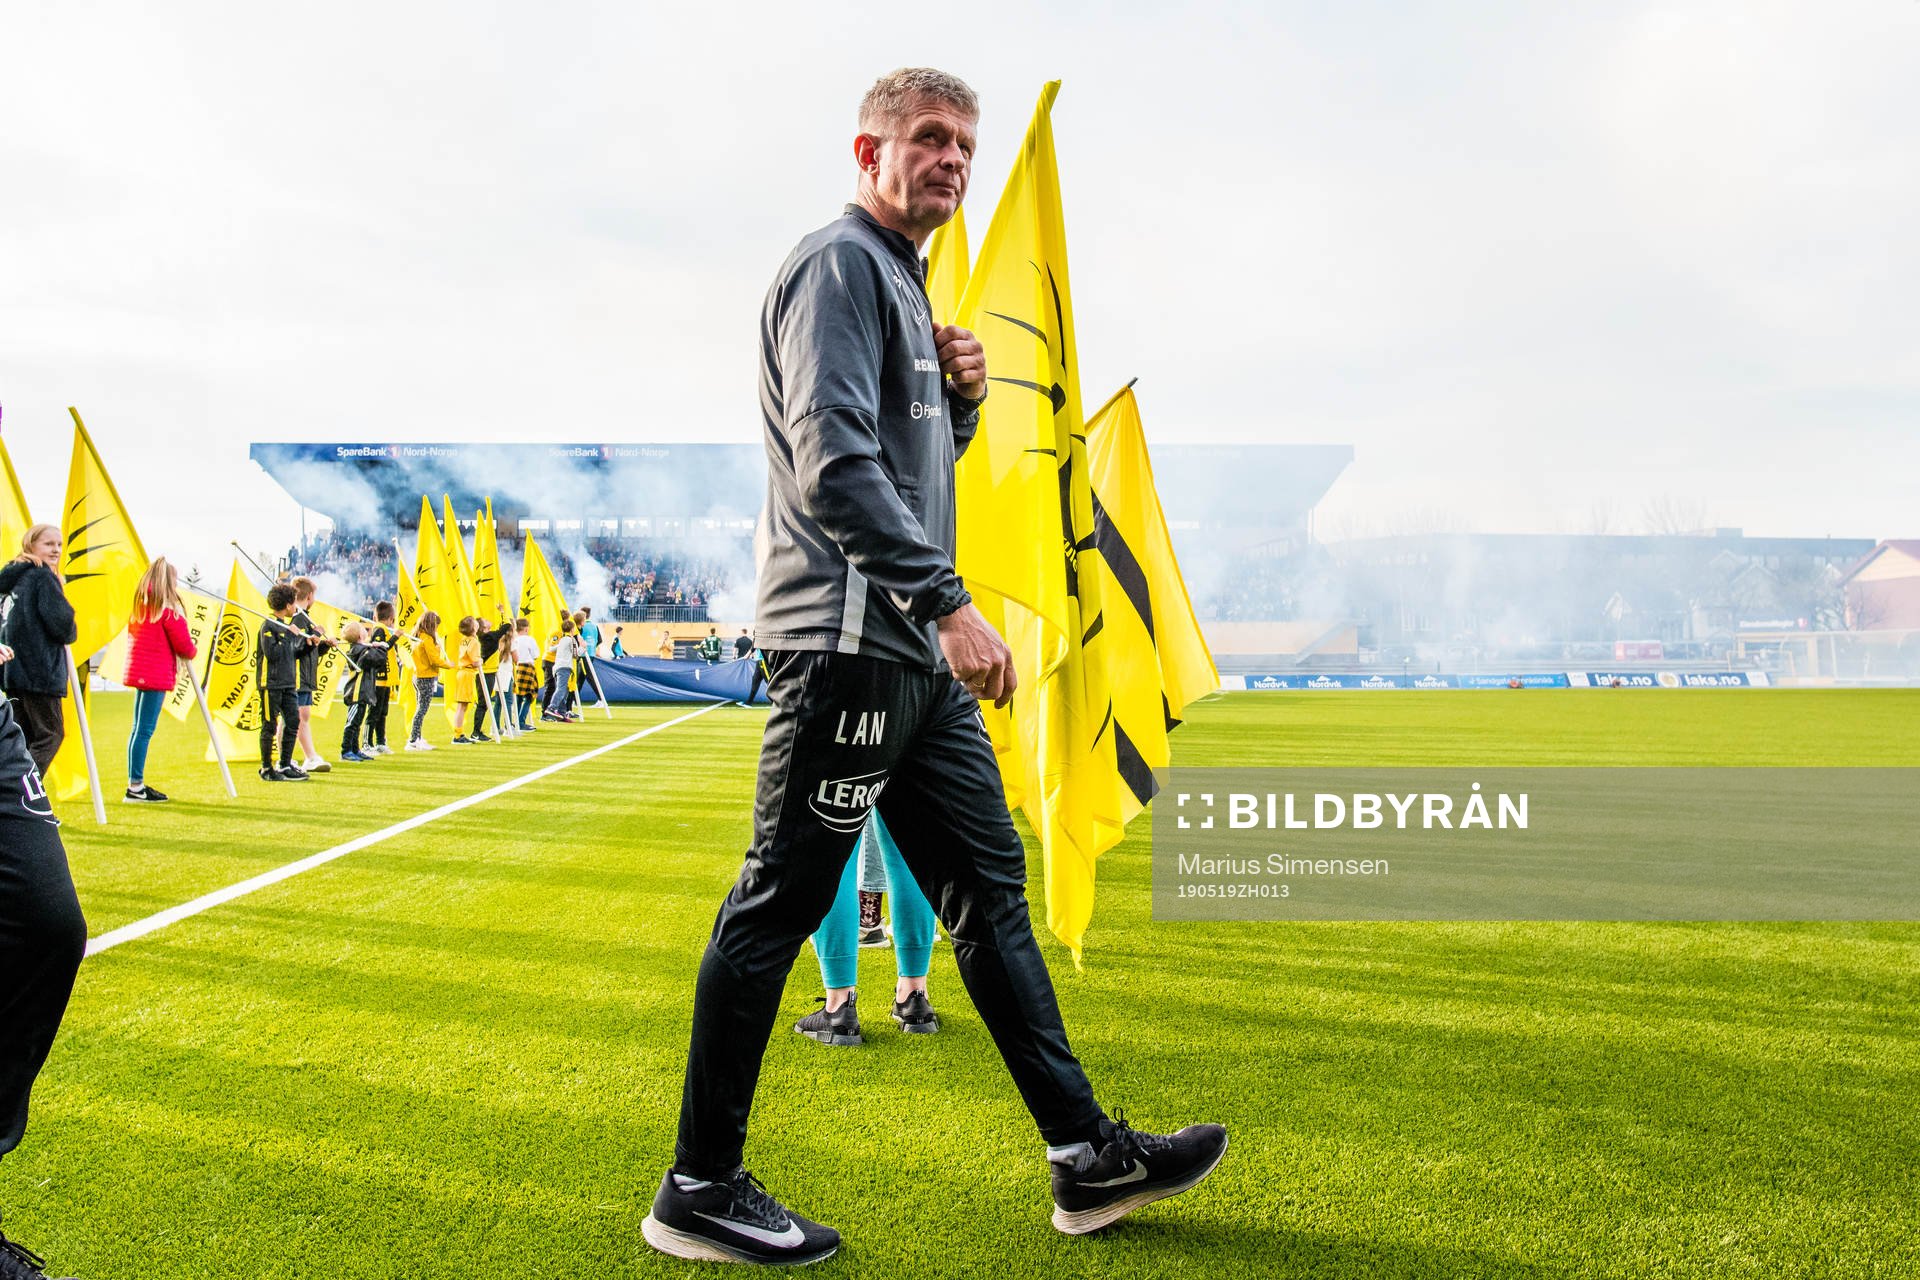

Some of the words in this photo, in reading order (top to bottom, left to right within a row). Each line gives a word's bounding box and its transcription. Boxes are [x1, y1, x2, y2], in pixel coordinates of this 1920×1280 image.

[337, 447, 386, 458] SpareBank
[403, 447, 458, 458] Nord-Norge
[1307, 680, 1342, 688] Nordvik
[1361, 680, 1395, 688] Nordvik
[1685, 674, 1741, 686] laks.no
[835, 710, 886, 745] LAN
